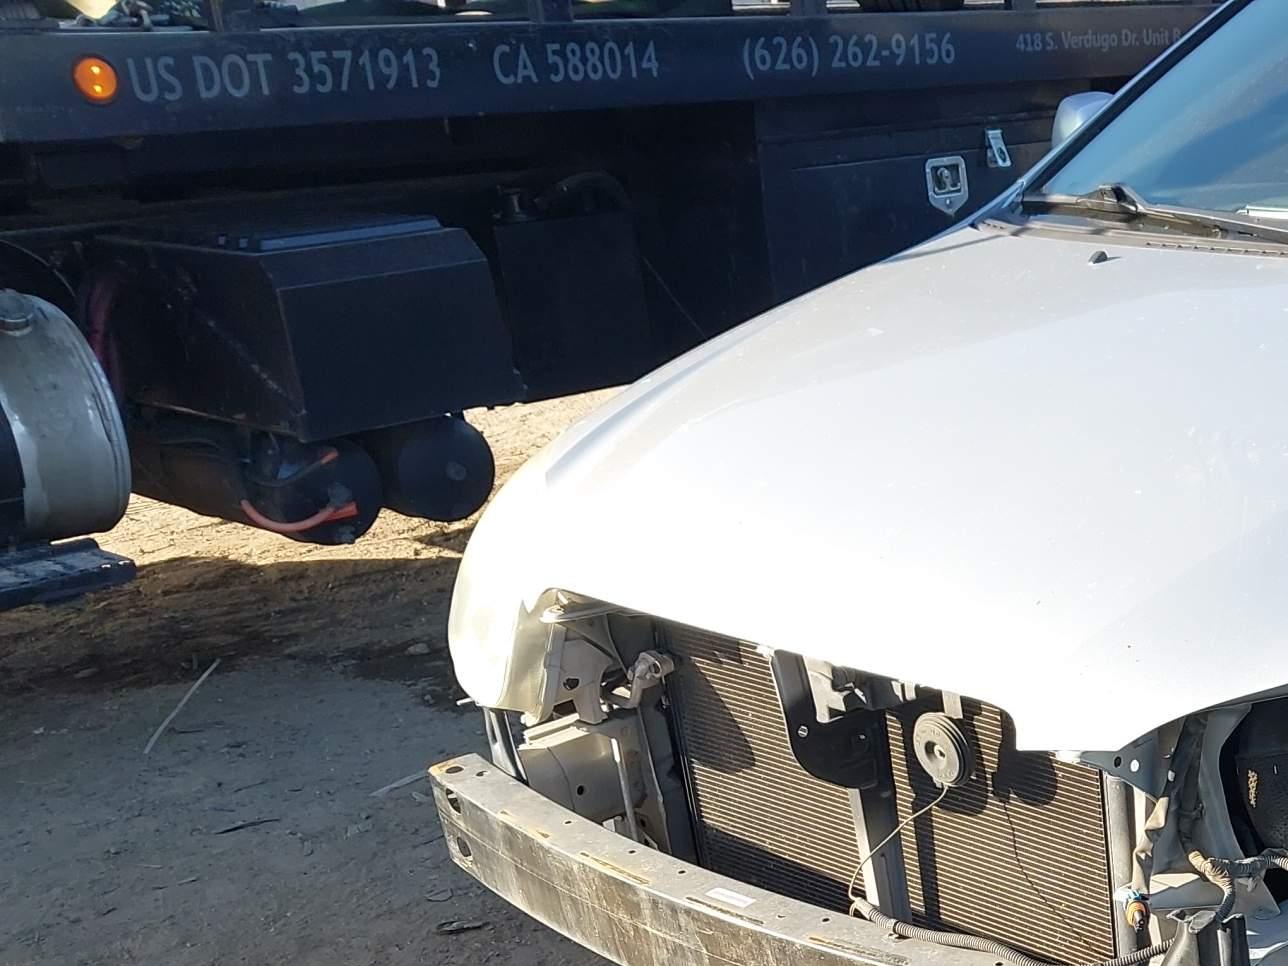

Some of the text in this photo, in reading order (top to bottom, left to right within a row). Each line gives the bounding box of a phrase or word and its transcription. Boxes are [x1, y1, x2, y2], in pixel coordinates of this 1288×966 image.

[493, 40, 658, 85] CA 588014
[742, 32, 956, 80] (626) 262-9156
[1015, 33, 1043, 51] 418
[1045, 32, 1058, 50] S.
[1061, 29, 1118, 52] Verdugo
[1122, 28, 1140, 47] Dr.
[1143, 28, 1170, 46] Unit
[126, 48, 441, 103] US DOT 3571913
